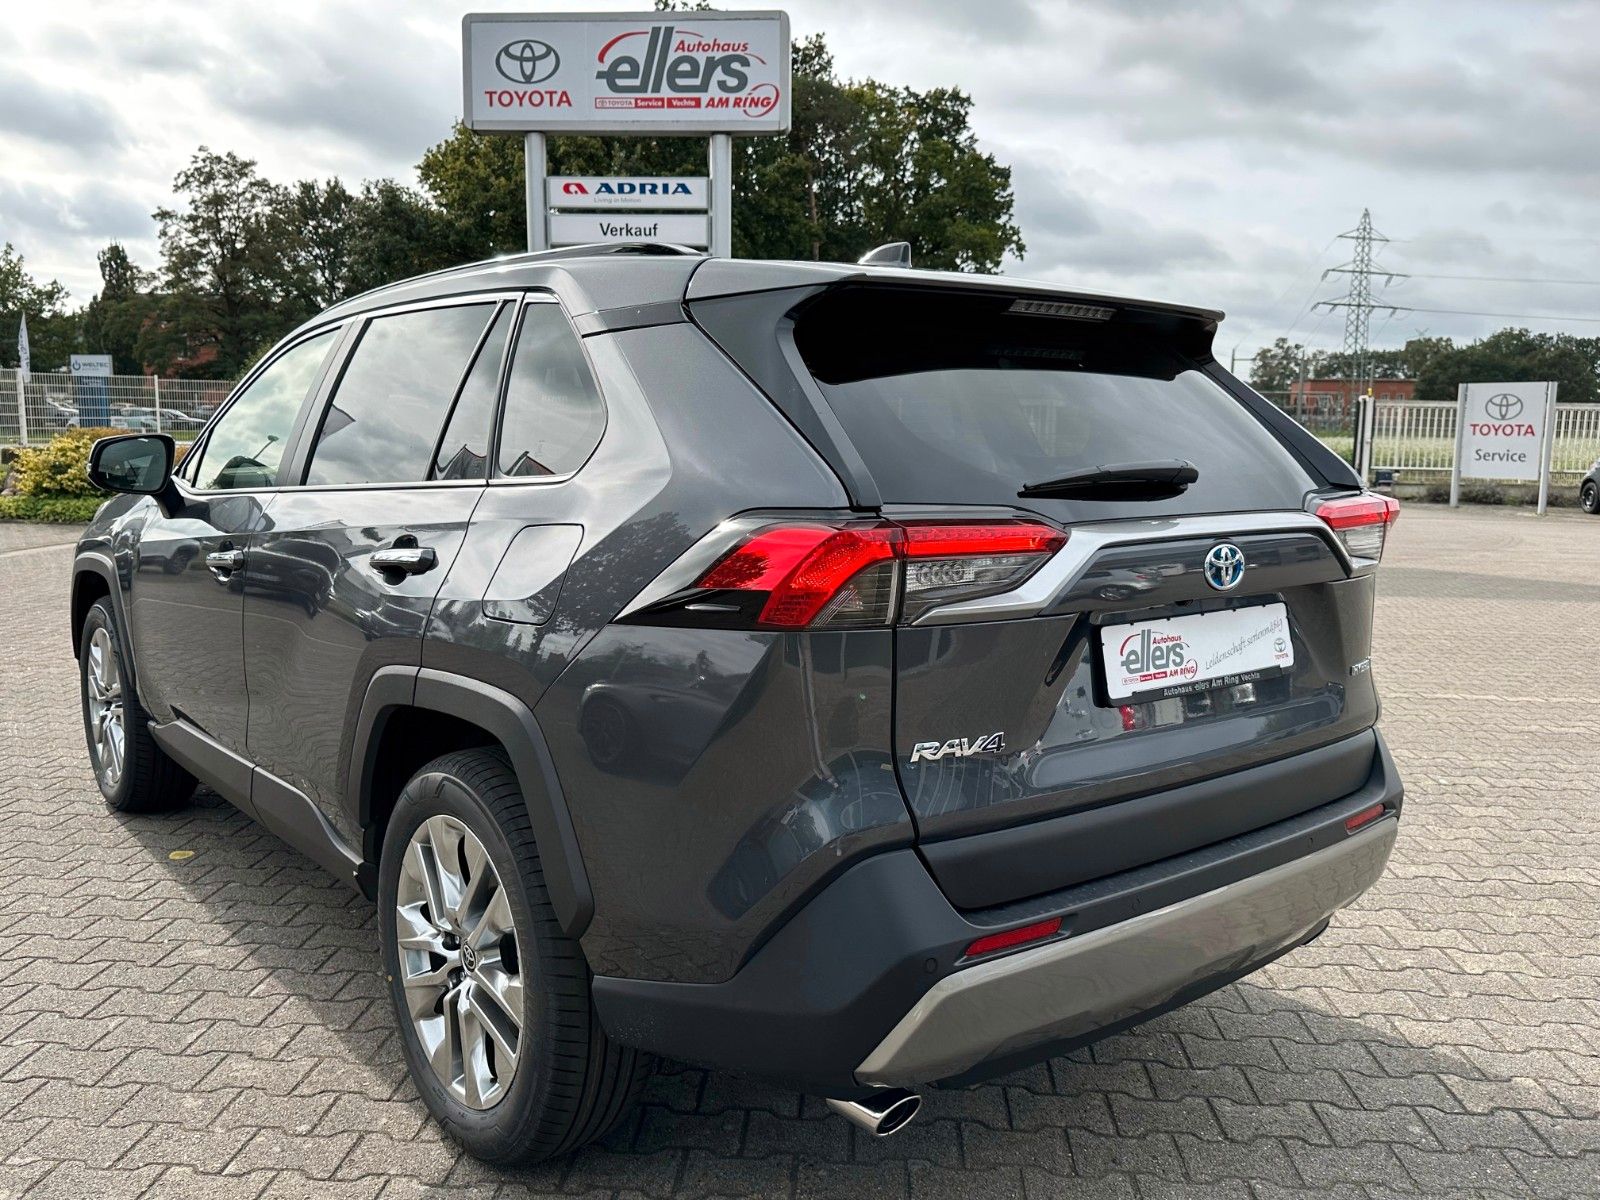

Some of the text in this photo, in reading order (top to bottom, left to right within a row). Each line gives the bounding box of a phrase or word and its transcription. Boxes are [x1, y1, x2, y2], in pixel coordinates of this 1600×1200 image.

[675, 39, 748, 53] Autohaus
[595, 26, 751, 94] ellers
[484, 90, 572, 108] TOYOTA
[637, 98, 663, 106] Service
[671, 98, 696, 106] Vechta
[705, 96, 772, 109] AM RING
[595, 182, 692, 195] ADRIA
[599, 223, 658, 237] Verkauf
[1470, 423, 1535, 436] TOYOTA
[1475, 449, 1527, 462] Service
[1152, 635, 1182, 644] Autohaus
[1121, 629, 1184, 675] ellers
[1169, 669, 1179, 677] AM
[1163, 685, 1193, 697] Autohaus
[1211, 678, 1223, 687] Am
[1224, 675, 1239, 684] Ring
[910, 731, 1005, 763] RAV4
